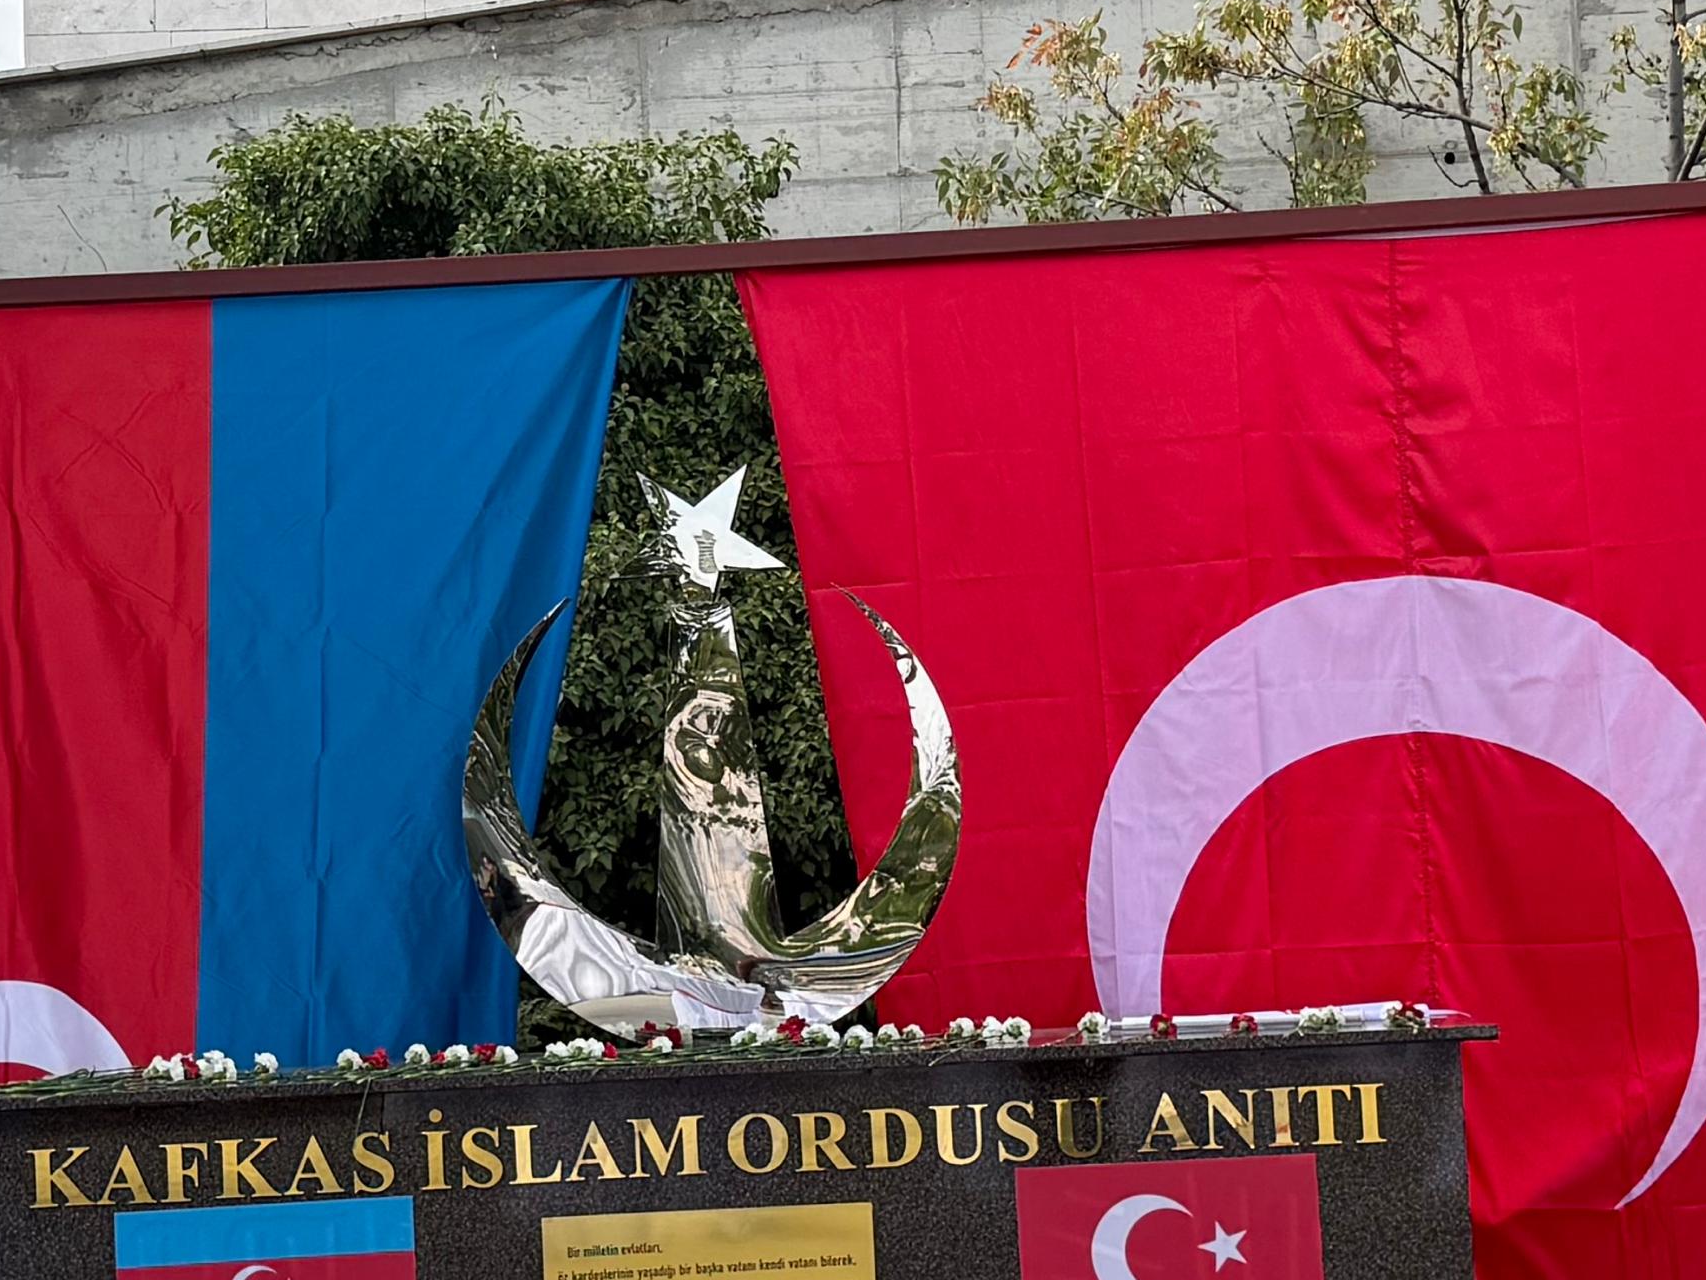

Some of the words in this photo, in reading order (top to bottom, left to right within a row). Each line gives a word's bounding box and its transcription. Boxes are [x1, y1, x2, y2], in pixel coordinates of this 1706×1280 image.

[30, 1131, 395, 1209] KAFKAS
[424, 1110, 701, 1190] İSLAM
[728, 1097, 1100, 1173] ORDUSU
[1143, 1083, 1386, 1152] ANITI
[679, 1264, 691, 1275] bir
[696, 1262, 724, 1277] başka
[727, 1262, 756, 1272] vatanı
[759, 1258, 785, 1270] kendi
[788, 1258, 817, 1269] vatanı
